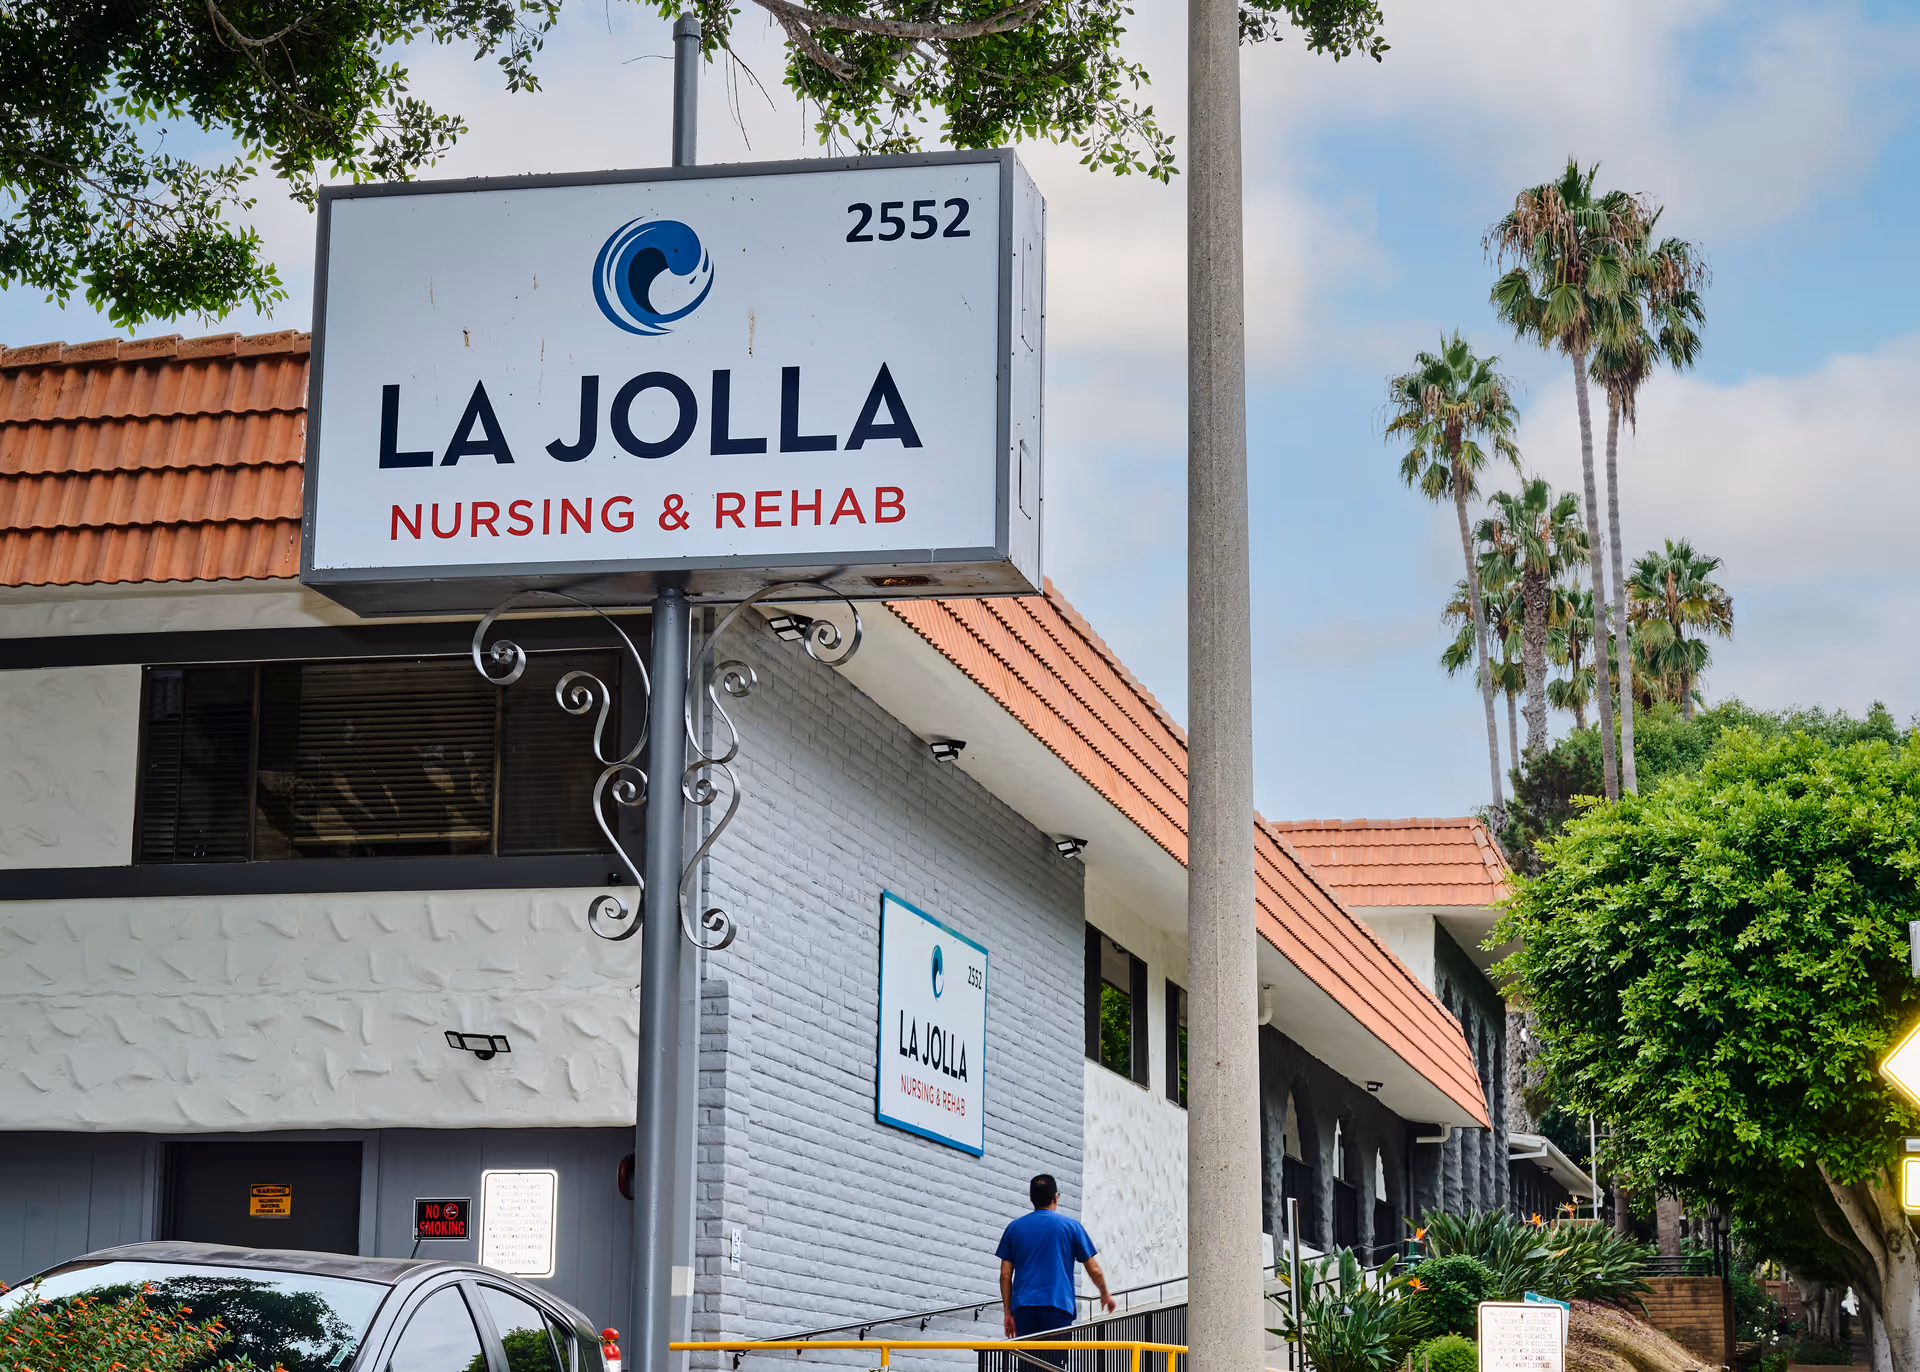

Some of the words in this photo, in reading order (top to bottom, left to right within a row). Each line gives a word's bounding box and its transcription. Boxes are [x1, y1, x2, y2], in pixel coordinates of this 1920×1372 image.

[845, 197, 971, 243] 2552
[379, 379, 516, 470] LA
[544, 361, 924, 463] JOLLA
[390, 495, 635, 541] NURSING
[658, 493, 691, 532] &
[715, 486, 907, 530] REHAB
[968, 965, 983, 991] 2552
[899, 1009, 919, 1062] LA
[922, 1021, 968, 1084] JOLLA
[900, 1073, 935, 1105] NURSING
[935, 1087, 941, 1108] &
[942, 1089, 966, 1117] REHAB
[419, 1220, 465, 1236] SMOKING
[425, 1204, 440, 1219] NO
